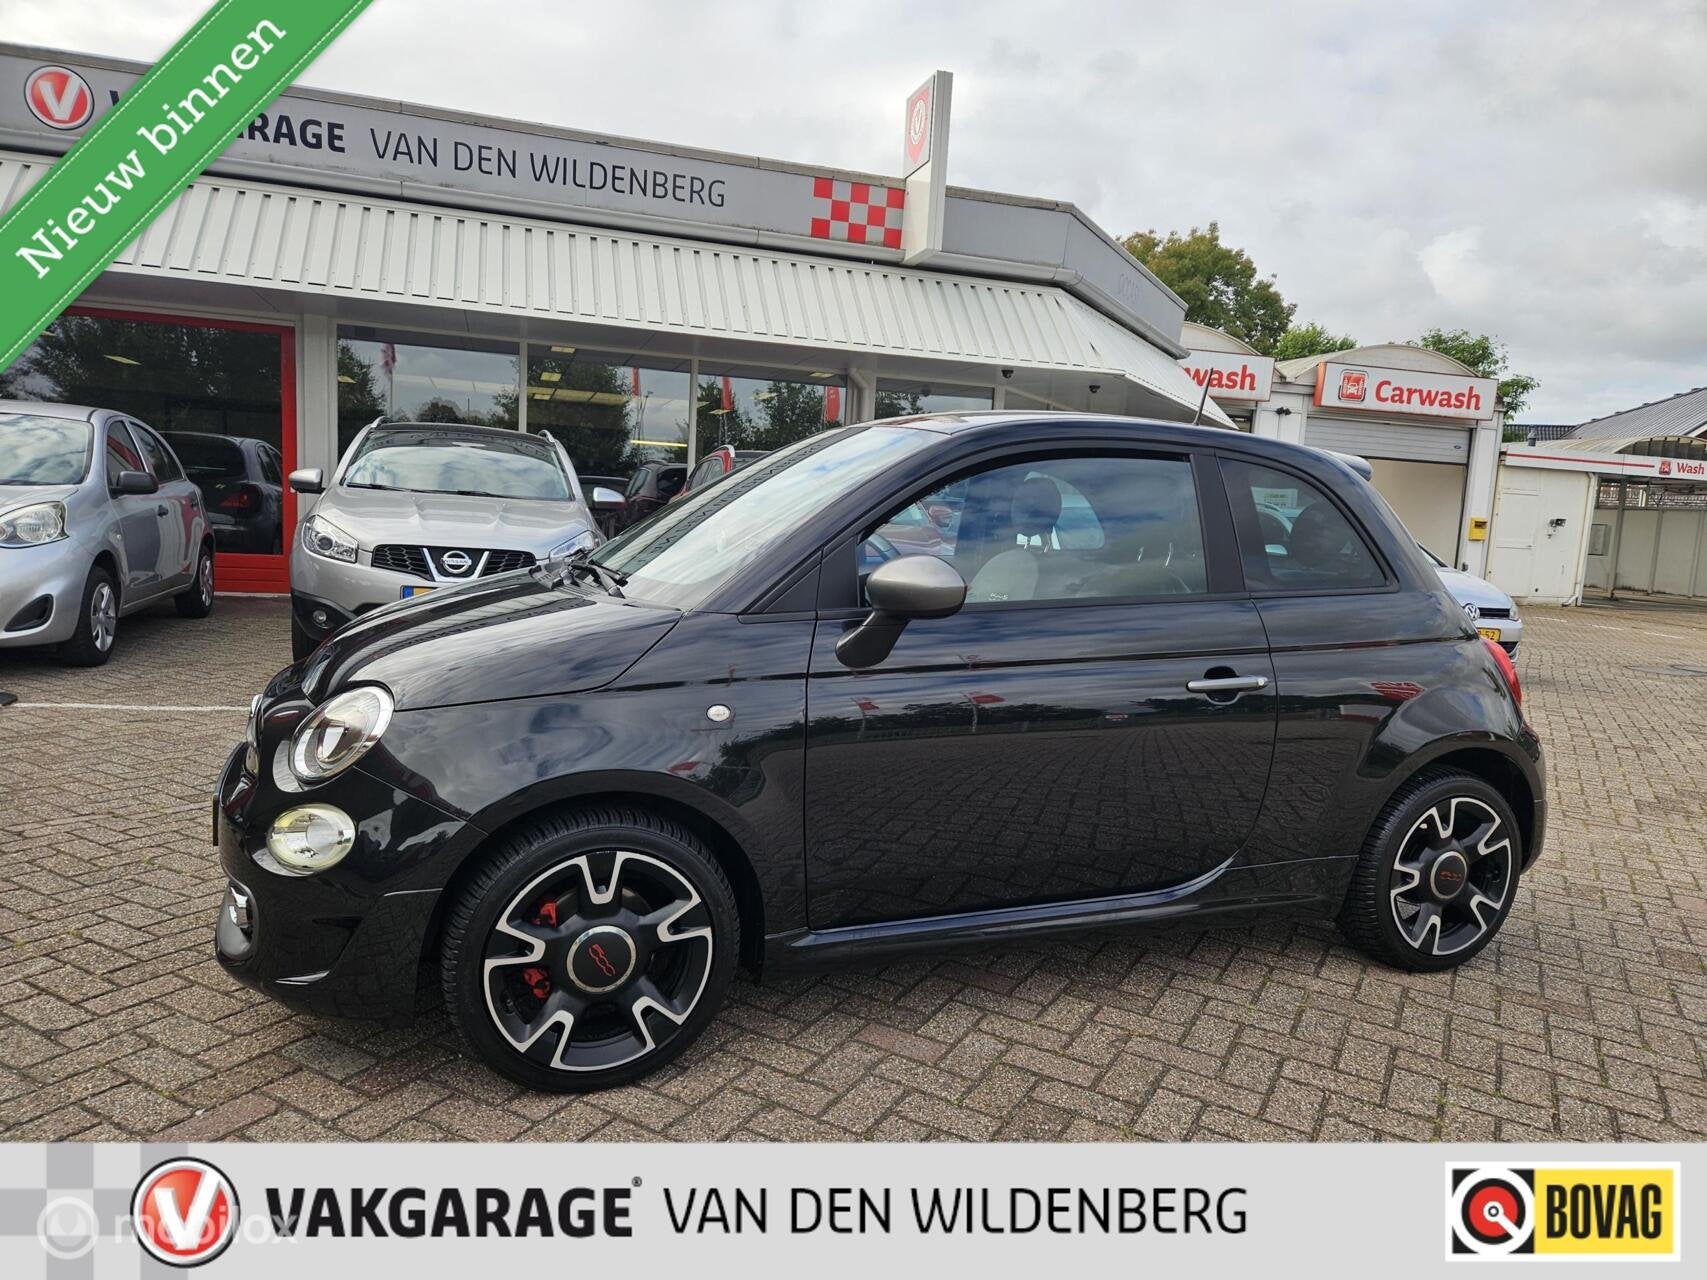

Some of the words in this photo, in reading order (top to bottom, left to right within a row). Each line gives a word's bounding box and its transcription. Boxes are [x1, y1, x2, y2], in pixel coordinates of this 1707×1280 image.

[370, 127, 438, 167] VAN
[454, 141, 517, 179] DEN
[529, 152, 726, 208] WILDENBERG
[1374, 379, 1481, 411] Carwash
[1676, 462, 1705, 475] Wash
